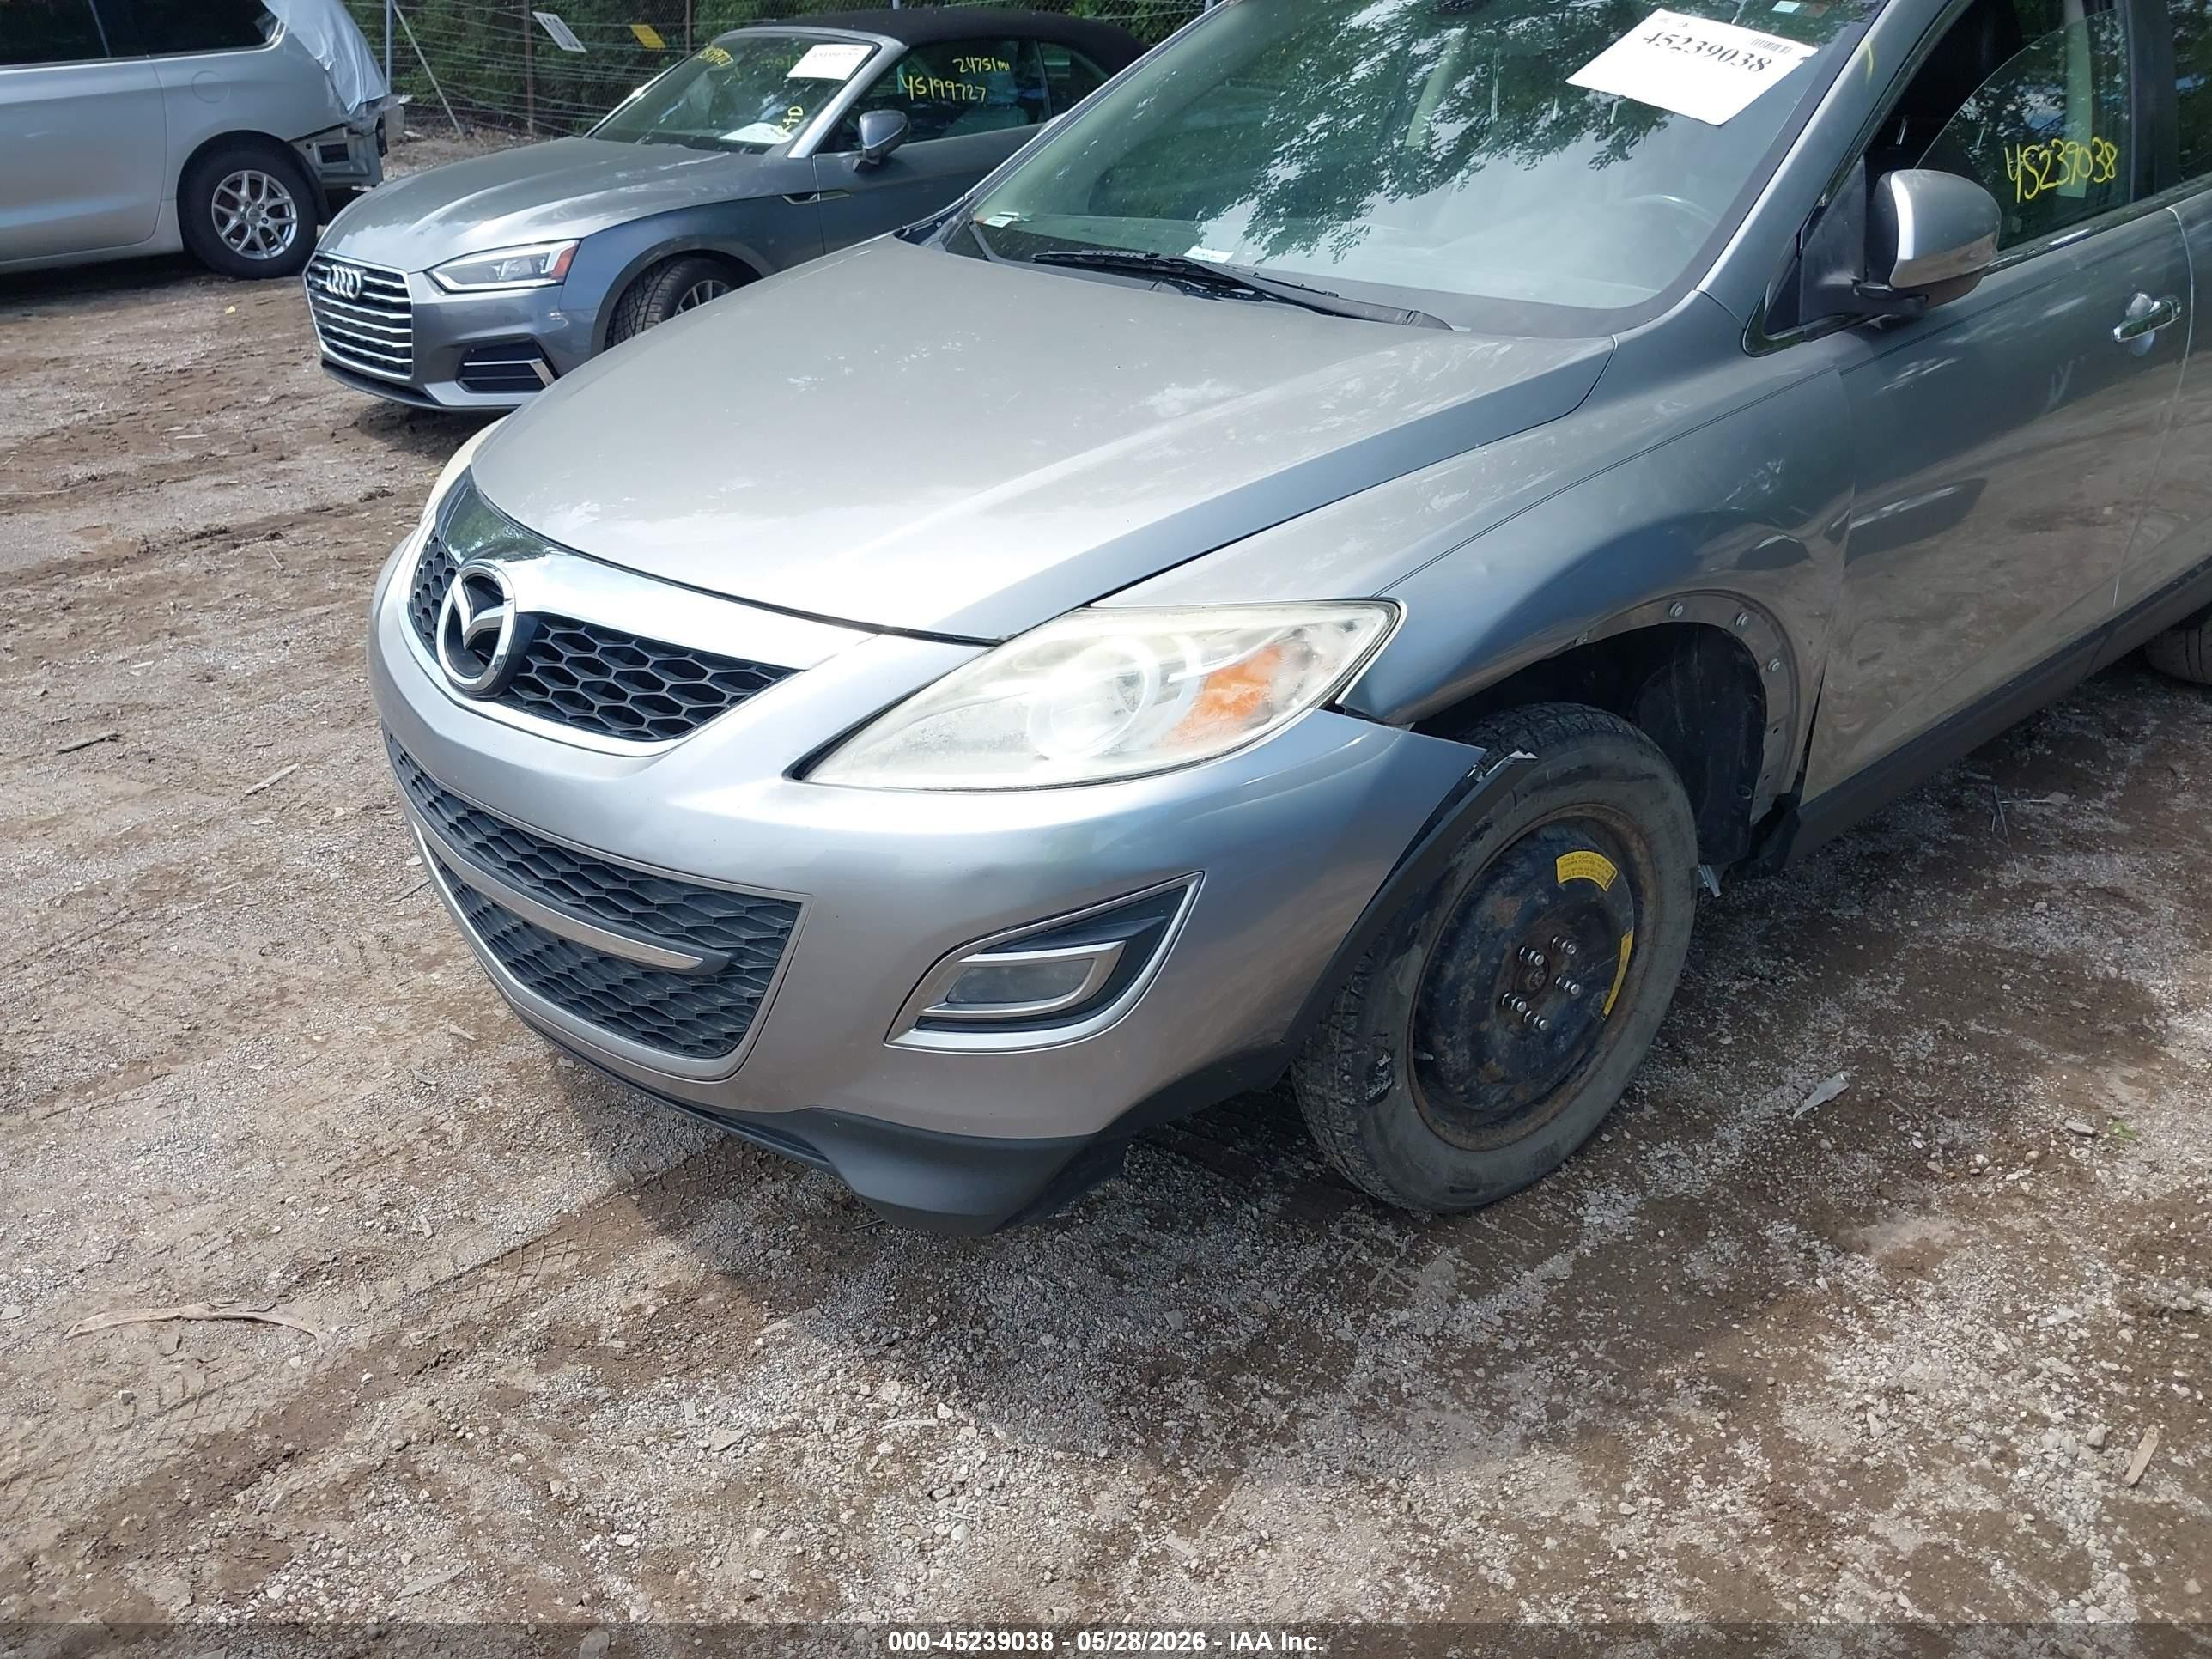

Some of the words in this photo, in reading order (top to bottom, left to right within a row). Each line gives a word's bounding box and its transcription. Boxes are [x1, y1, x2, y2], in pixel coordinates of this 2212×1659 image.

[1643, 31, 1772, 72] 45239038
[899, 74, 987, 102] 45199727
[2004, 137, 2118, 204] 45239038
